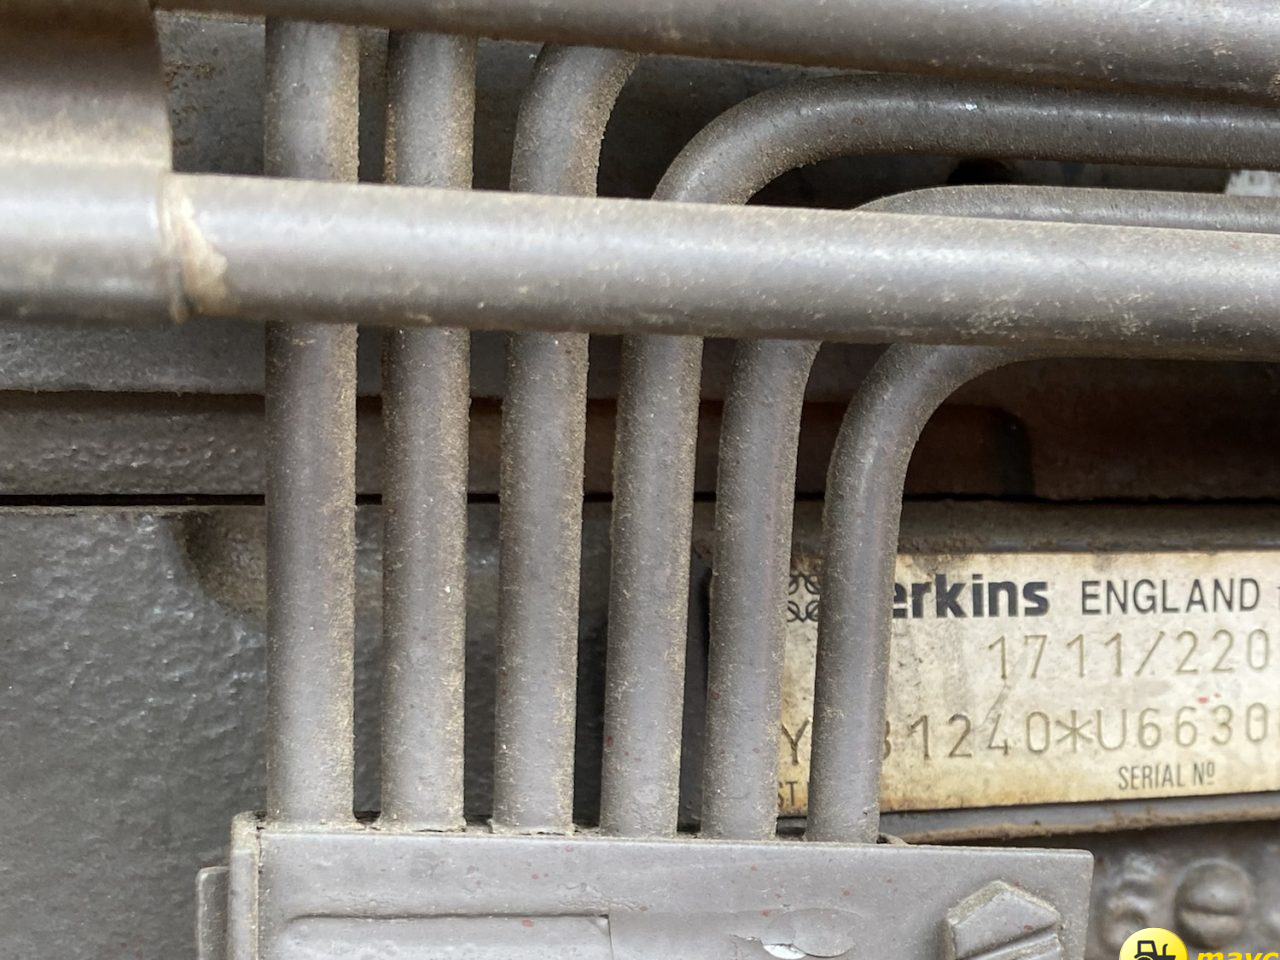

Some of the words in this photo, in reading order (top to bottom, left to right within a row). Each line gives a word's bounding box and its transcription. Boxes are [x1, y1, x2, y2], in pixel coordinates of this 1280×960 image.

[892, 573, 1050, 619] erkins
[1081, 578, 1261, 615] ENGLAND
[1118, 765, 1186, 791] SERIAL
